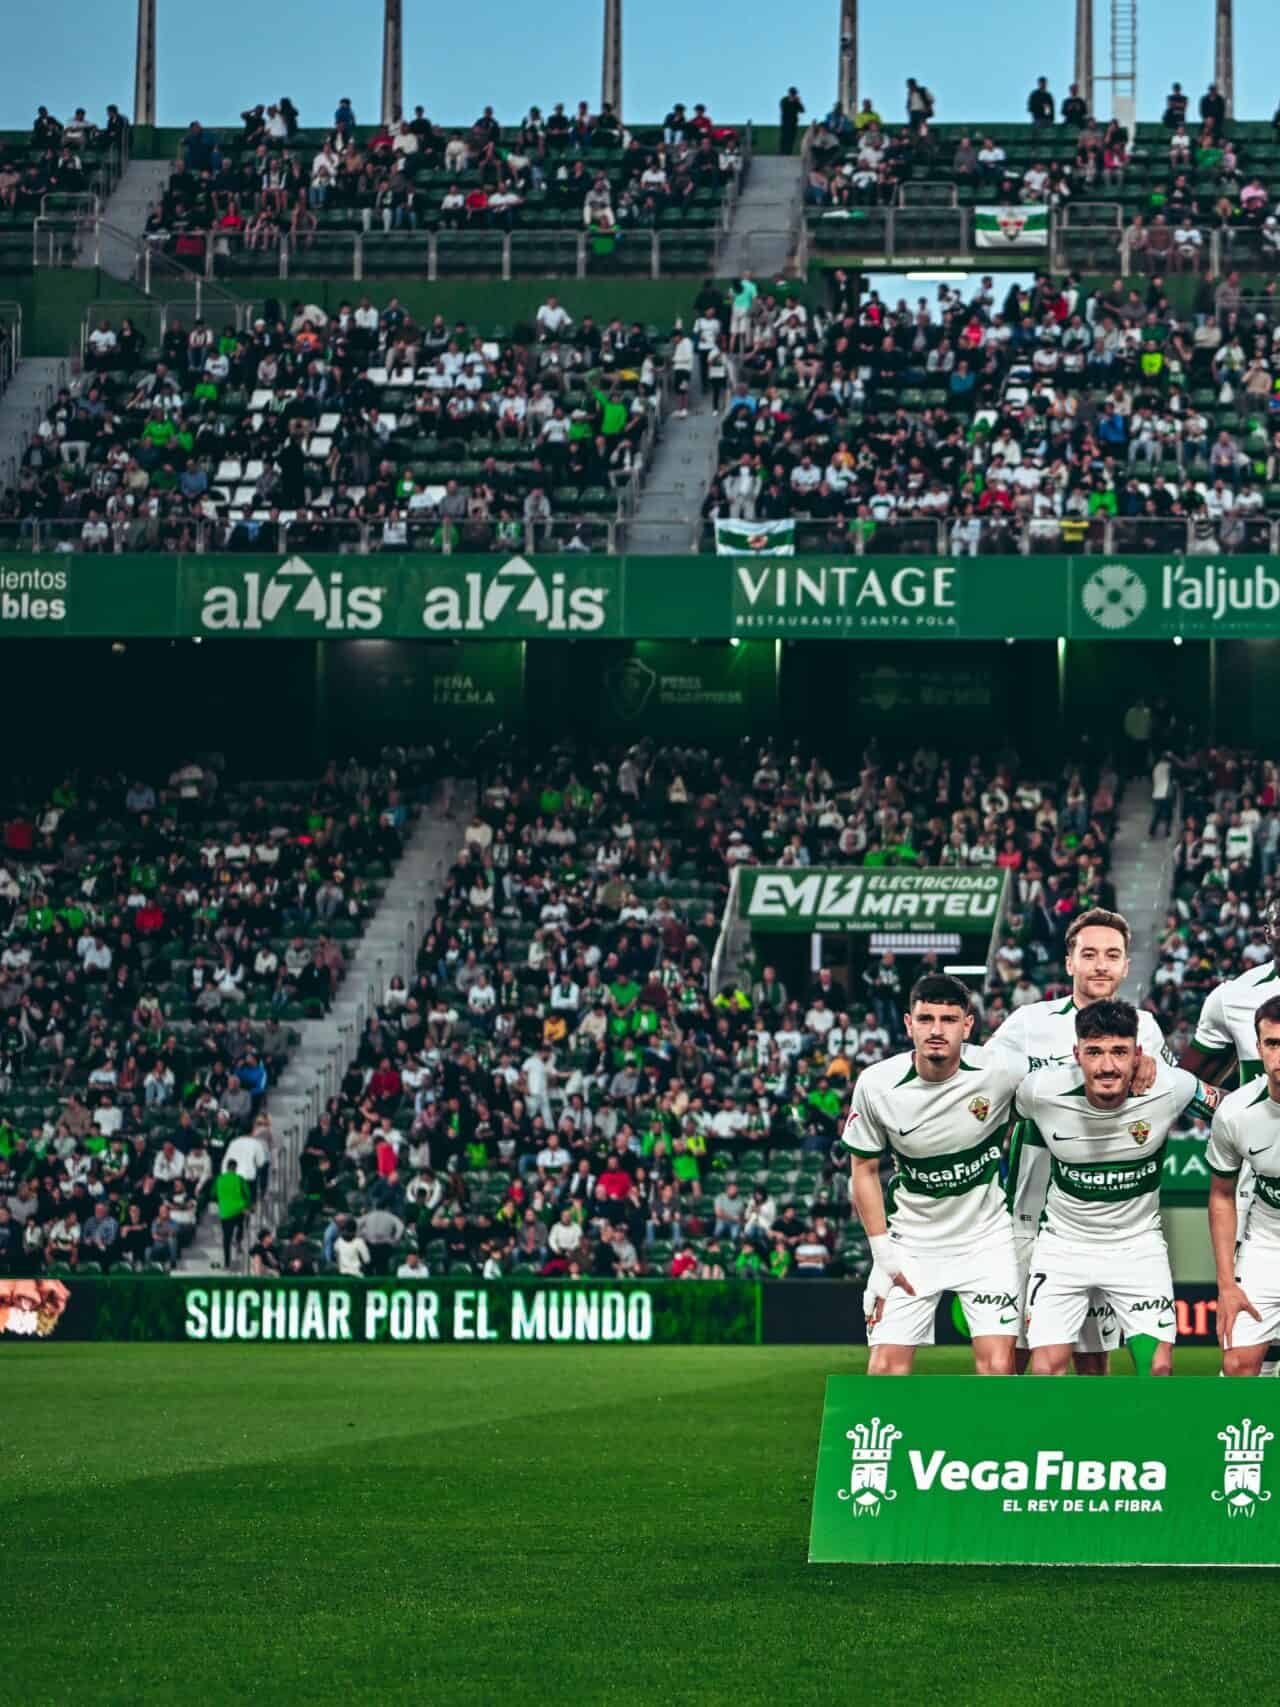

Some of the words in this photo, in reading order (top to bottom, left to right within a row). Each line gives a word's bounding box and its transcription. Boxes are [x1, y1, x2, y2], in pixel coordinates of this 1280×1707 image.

[0, 567, 67, 590] ientos
[737, 567, 956, 606] VINTAGE
[1163, 564, 1280, 619] l'aljub
[2, 592, 66, 620] bles
[735, 615, 854, 626] RESTAURANTE
[860, 615, 909, 626] SANTA
[916, 615, 957, 626] POLA
[867, 875, 998, 891] ELECTRICIDAD
[861, 893, 998, 917] MATEU
[185, 1289, 351, 1340] SUCHIAR
[365, 1290, 440, 1340] POR
[453, 1290, 498, 1340] EL
[511, 1291, 653, 1341] MUNDO
[1003, 1499, 1022, 1512] EL
[1028, 1499, 1058, 1512] REY
[1063, 1499, 1084, 1512] DE
[1089, 1499, 1110, 1513] LA
[1115, 1499, 1163, 1513] FIBRA
